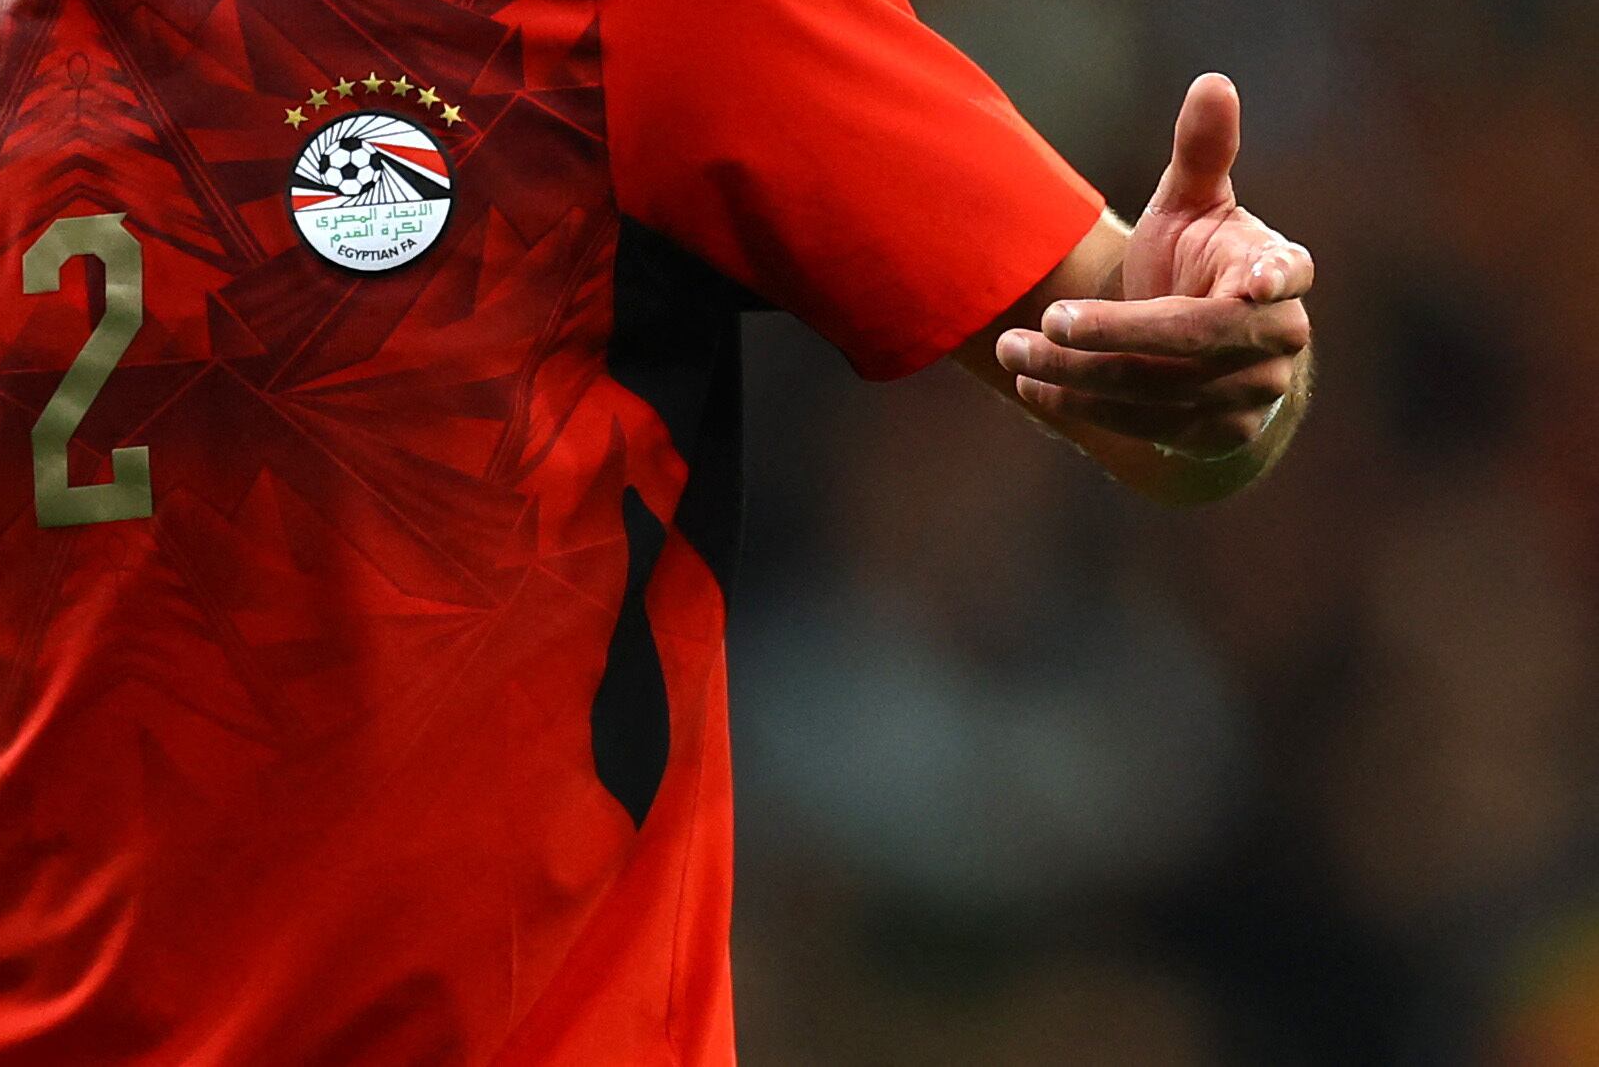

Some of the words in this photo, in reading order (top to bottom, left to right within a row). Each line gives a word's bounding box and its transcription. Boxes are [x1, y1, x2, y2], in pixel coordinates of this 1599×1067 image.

[385, 202, 433, 219] الاتحاد
[330, 224, 374, 247] القدم
[381, 219, 423, 241] لكرة
[337, 244, 399, 261] EGYPTIAN
[400, 238, 417, 253] FA
[22, 212, 153, 528] 2
